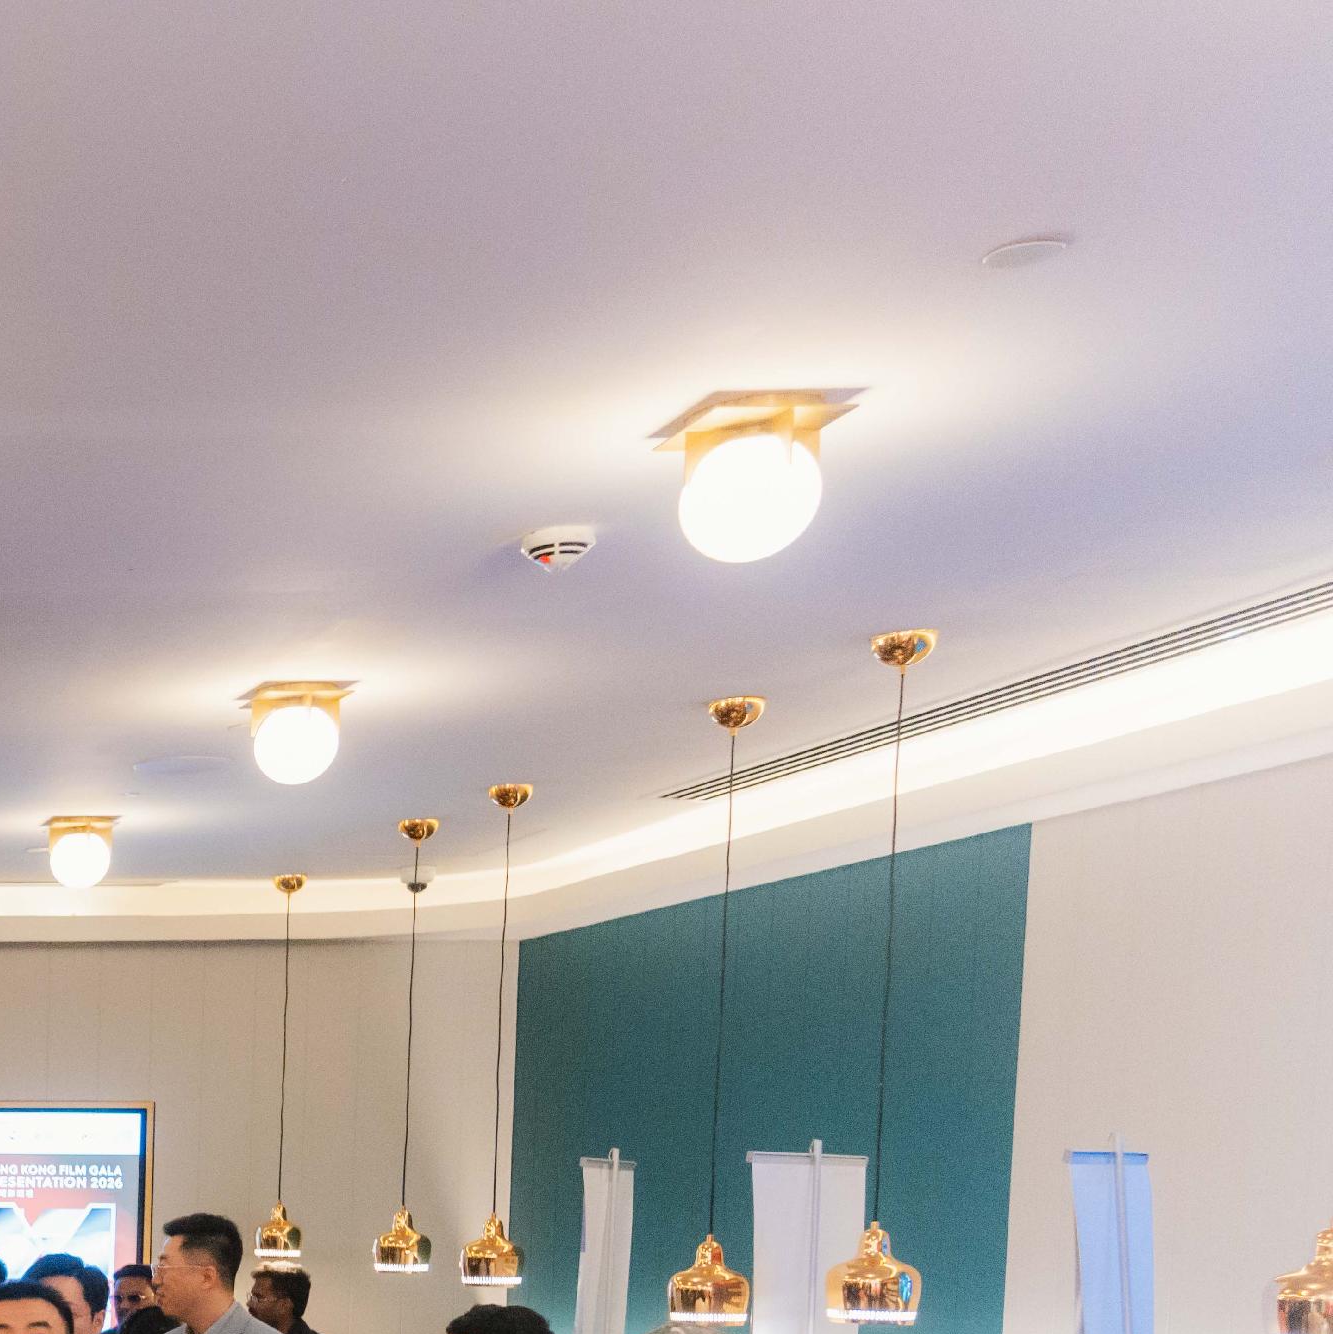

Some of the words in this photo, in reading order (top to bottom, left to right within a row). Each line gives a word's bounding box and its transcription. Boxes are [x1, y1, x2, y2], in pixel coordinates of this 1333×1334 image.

[20, 1164, 57, 1176] KONG
[58, 1165, 87, 1176] FILM
[88, 1165, 123, 1177] GALA
[90, 1177, 124, 1189] 2026
